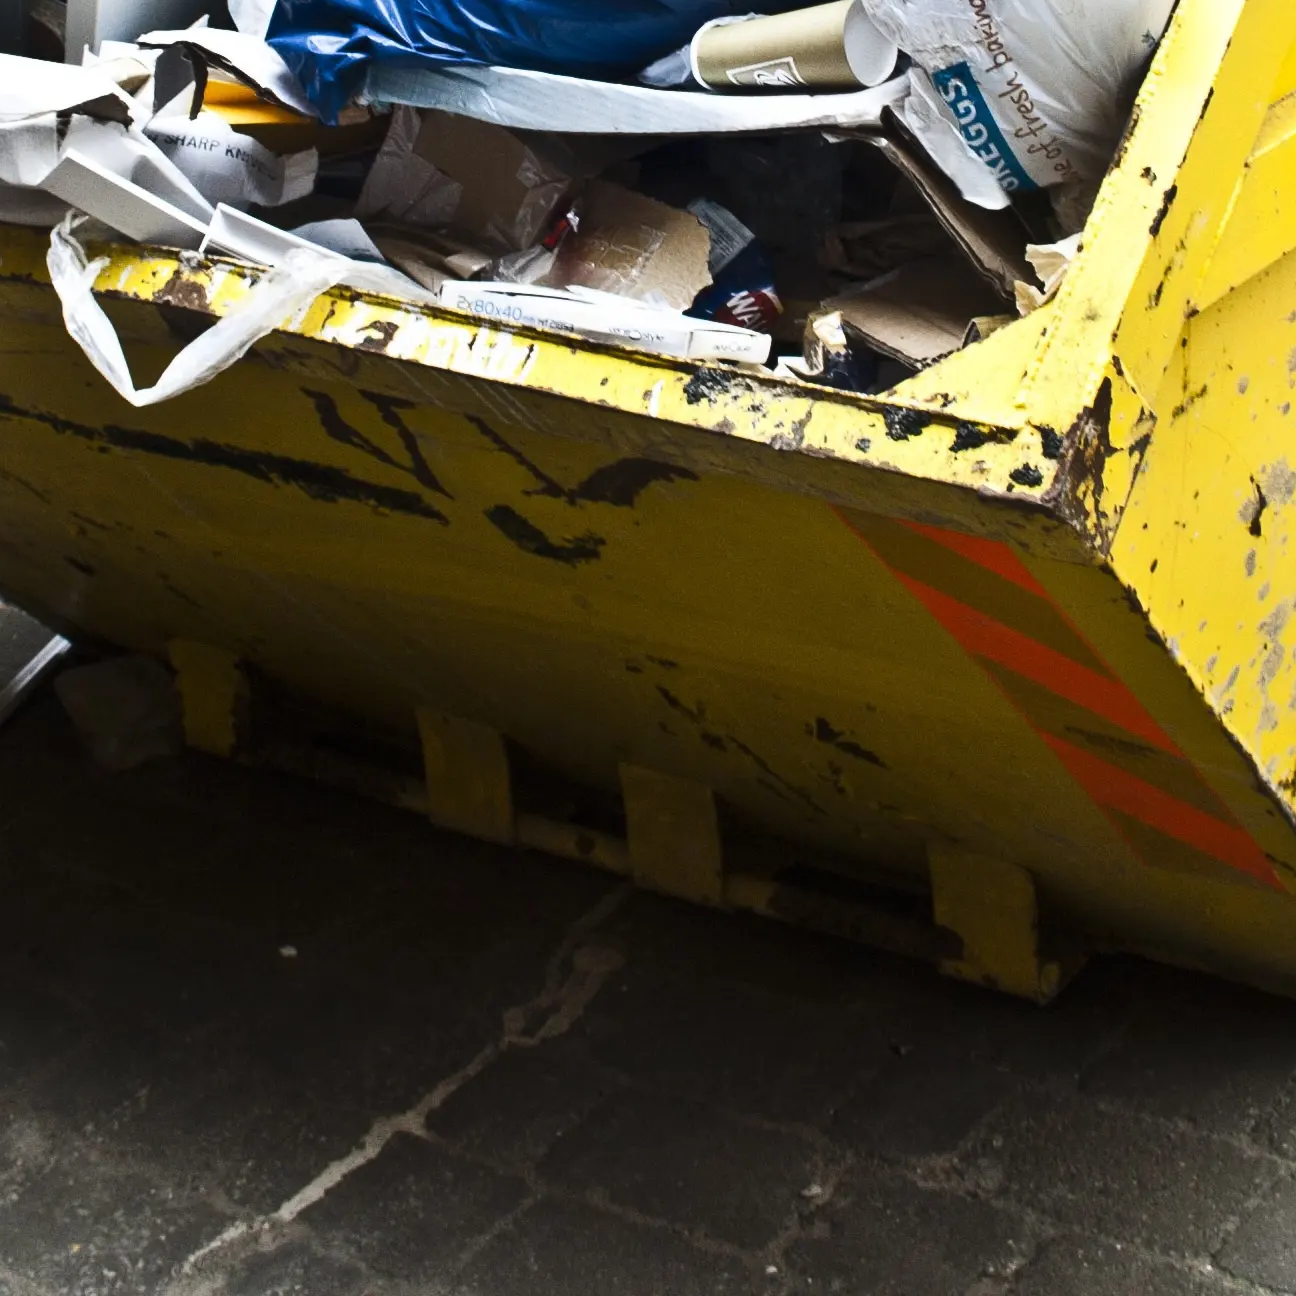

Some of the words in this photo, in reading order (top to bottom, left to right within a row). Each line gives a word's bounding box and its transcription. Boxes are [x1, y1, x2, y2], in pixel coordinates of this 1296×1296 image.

[998, 71, 1048, 139] fresh
[164, 134, 220, 152] SHARP
[1027, 135, 1062, 160] of
